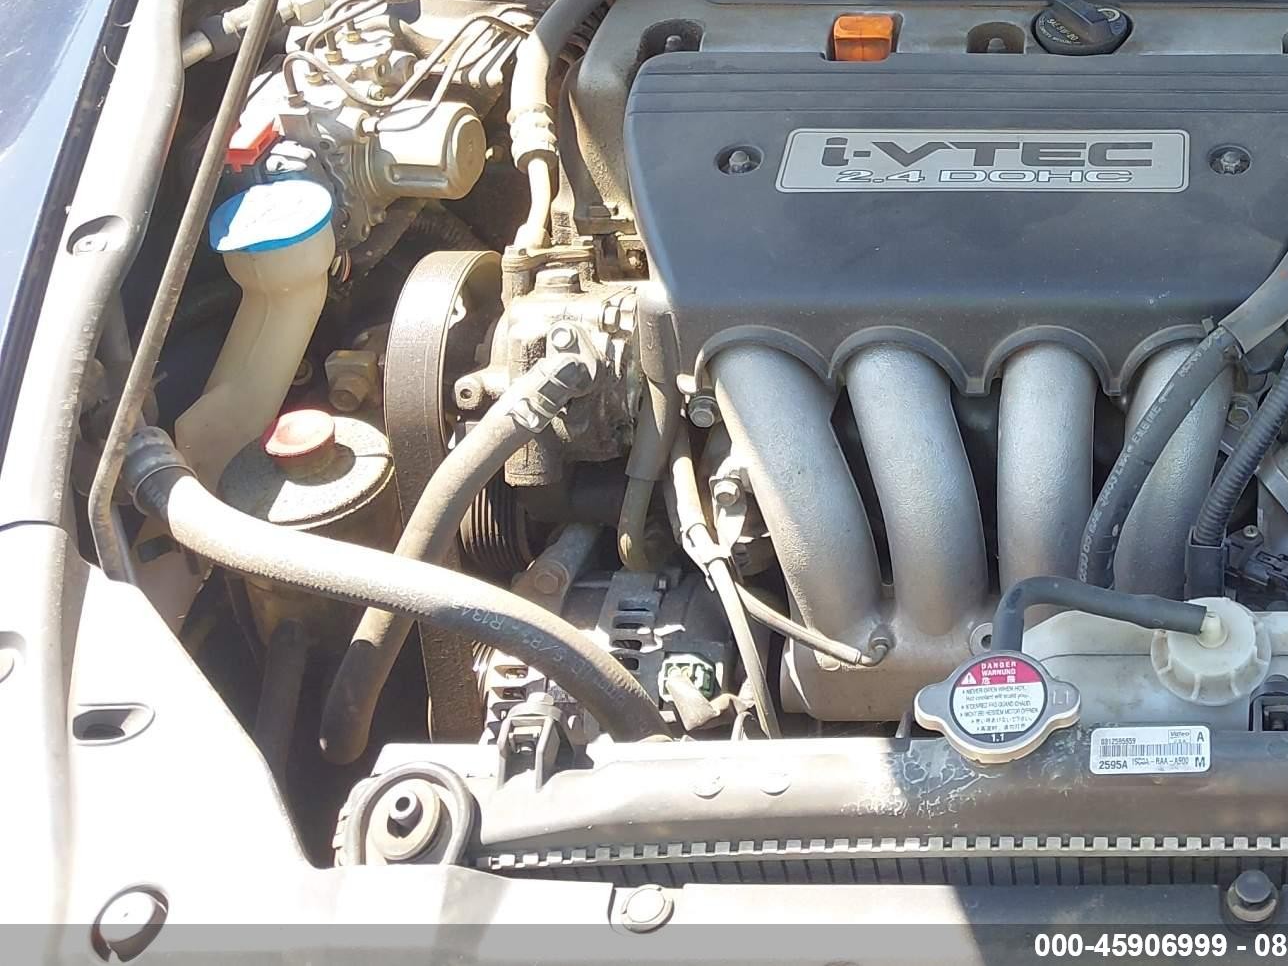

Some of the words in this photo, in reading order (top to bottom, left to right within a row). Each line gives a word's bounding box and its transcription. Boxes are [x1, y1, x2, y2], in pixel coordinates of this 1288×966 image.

[820, 136, 1153, 167] i-VTEC
[836, 168, 926, 183] 2.4
[938, 168, 1133, 183] DOHC
[981, 661, 1017, 670] DANGER
[981, 668, 1016, 676] WARNUNG
[991, 733, 1005, 742] 1.1
[1197, 731, 1205, 743] A
[1099, 760, 1128, 770] 2595A
[1194, 756, 1206, 768] M
